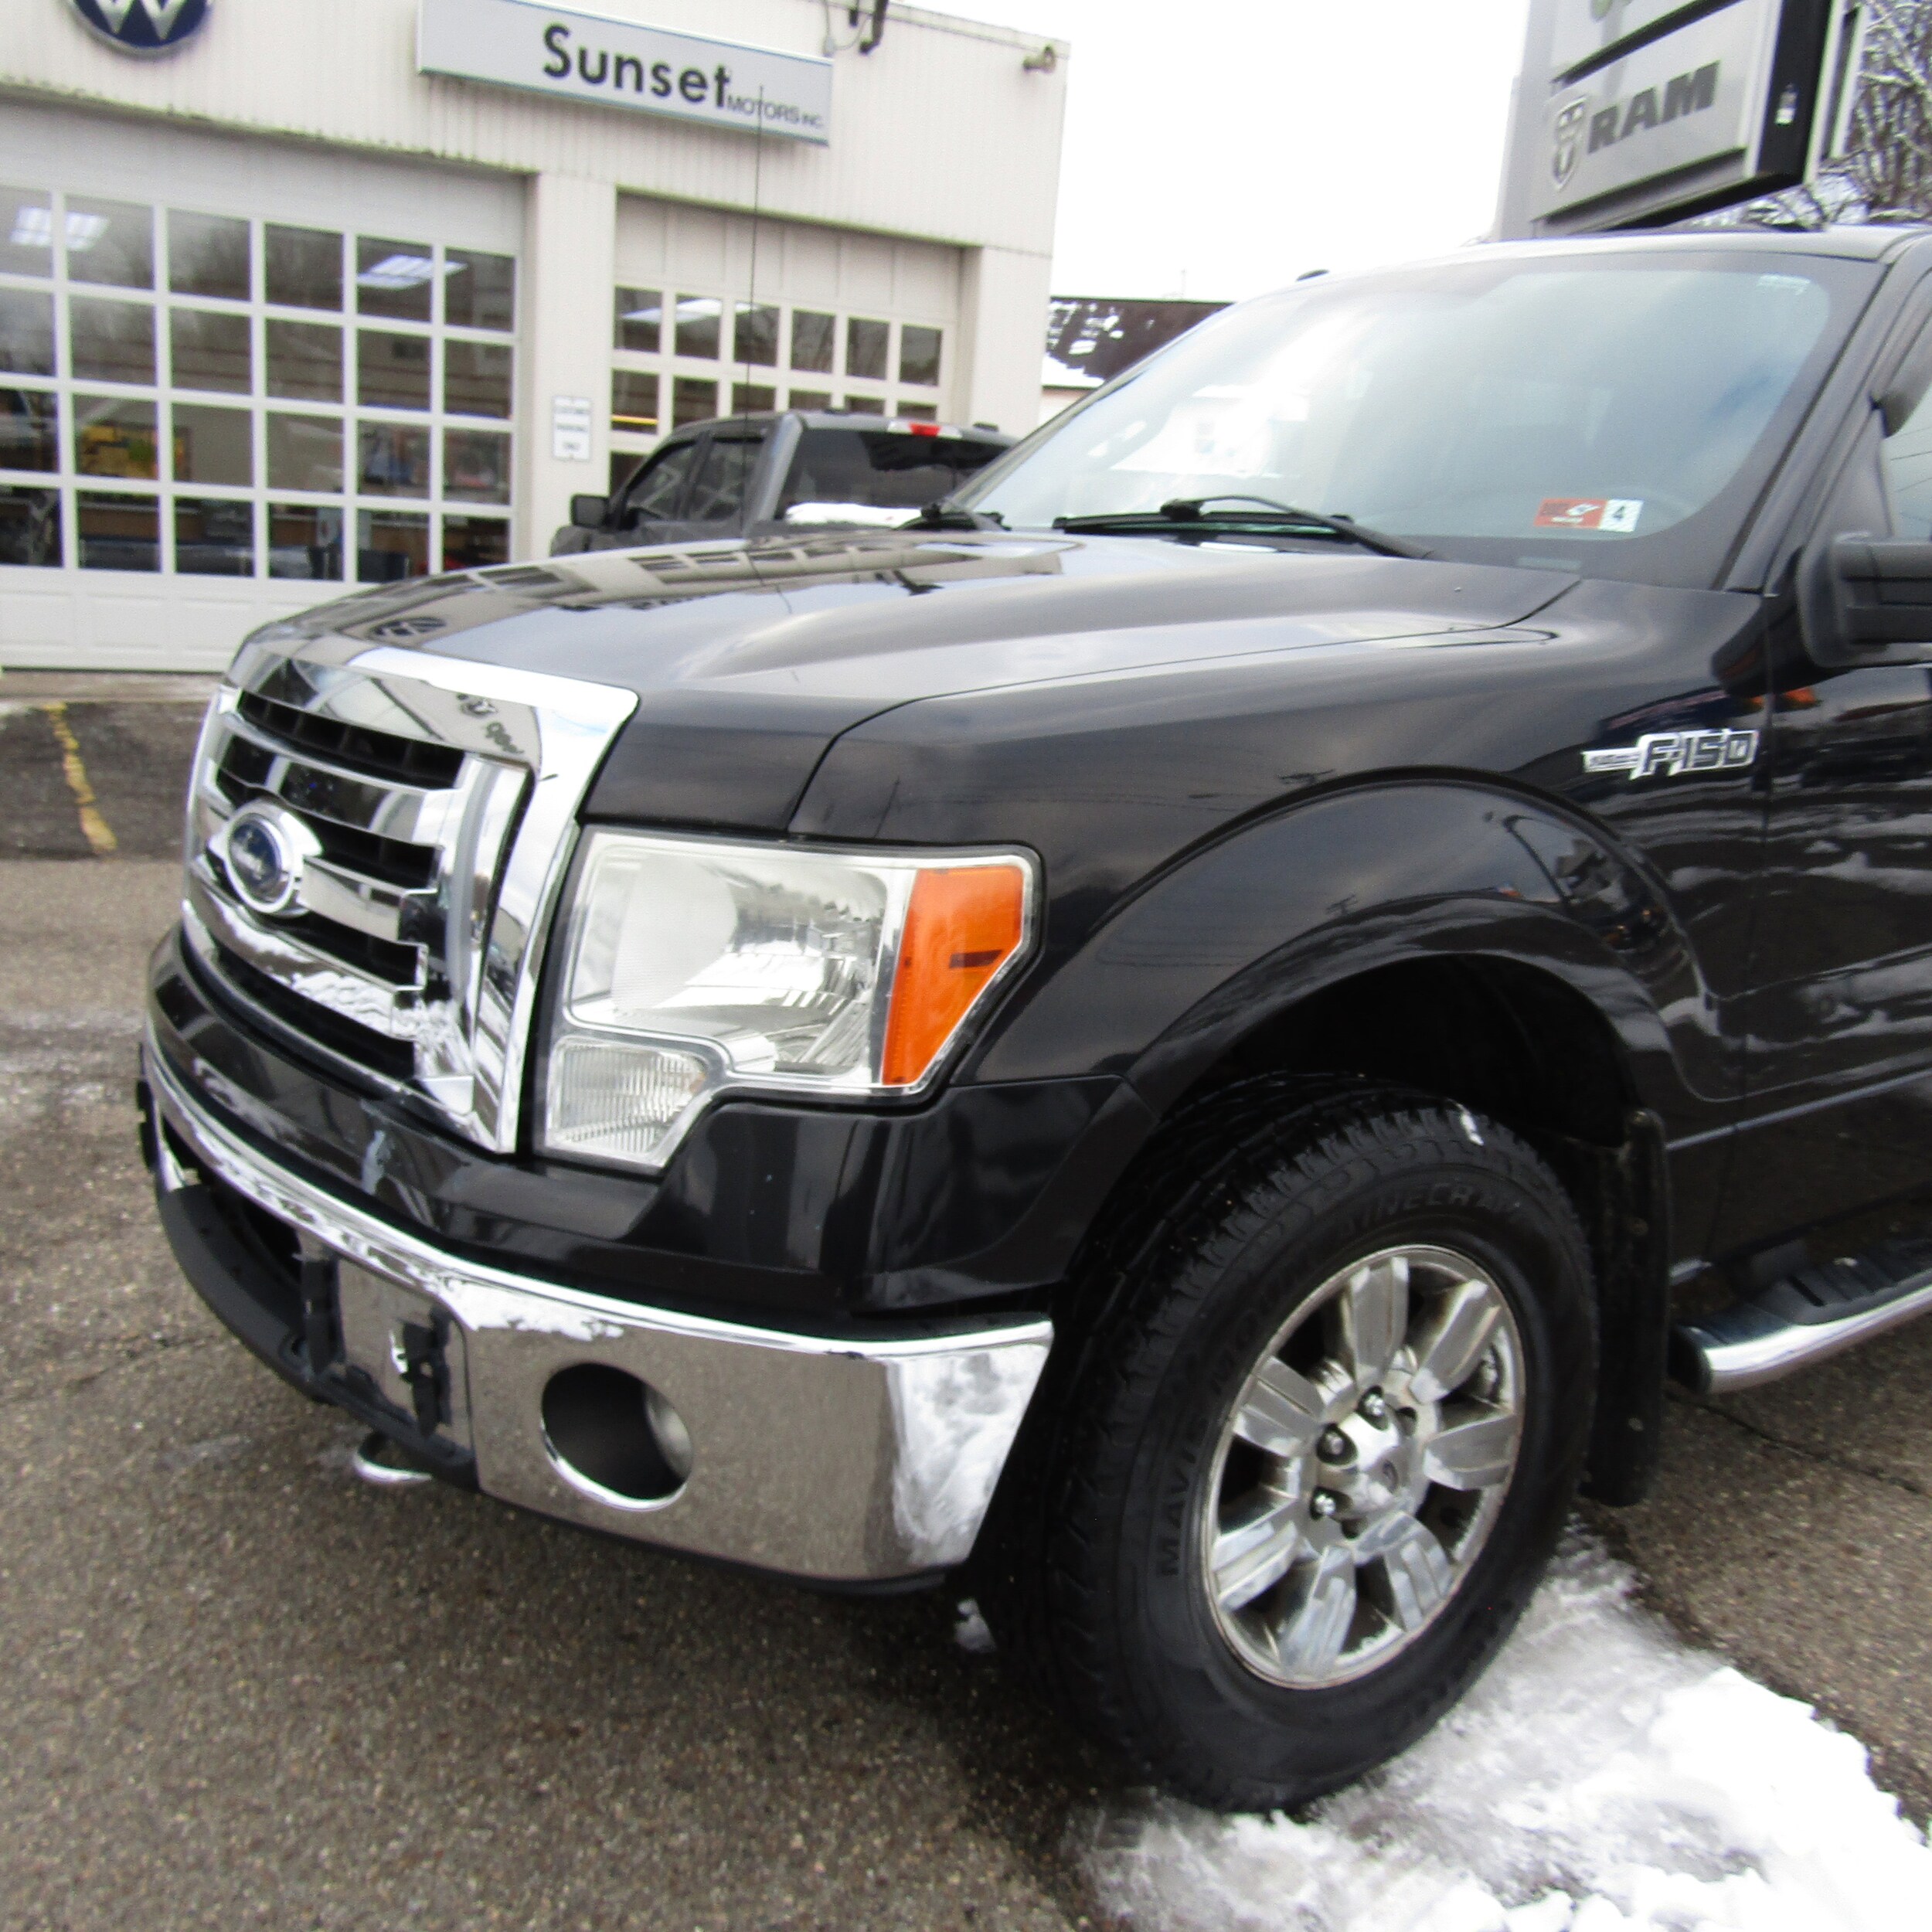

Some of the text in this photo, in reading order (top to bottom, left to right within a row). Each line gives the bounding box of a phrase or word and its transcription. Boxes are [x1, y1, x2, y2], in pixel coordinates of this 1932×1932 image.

[543, 22, 731, 108] Sunset
[1587, 60, 1721, 154] RAM
[1612, 505, 1626, 520] 4
